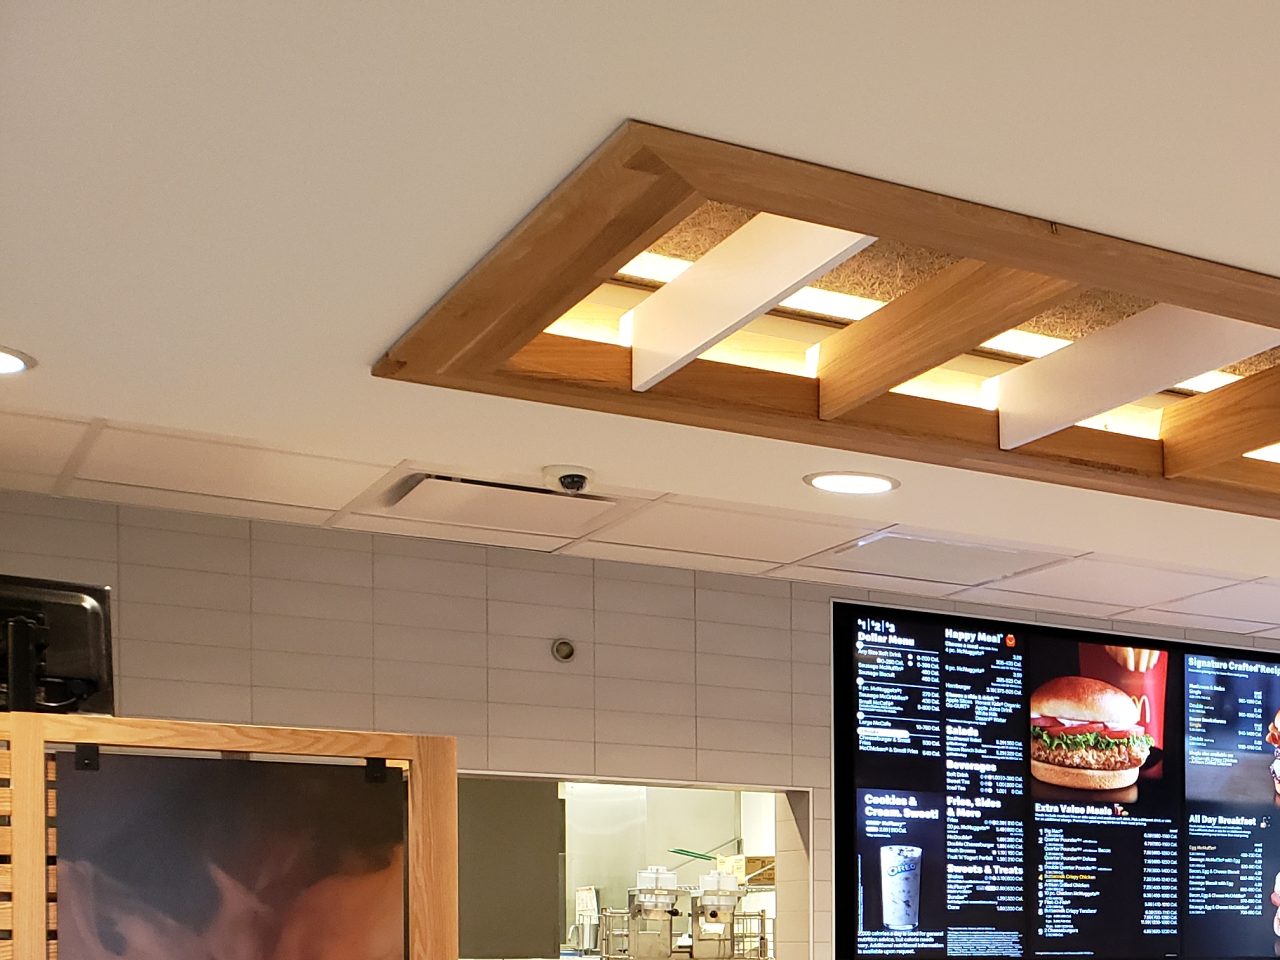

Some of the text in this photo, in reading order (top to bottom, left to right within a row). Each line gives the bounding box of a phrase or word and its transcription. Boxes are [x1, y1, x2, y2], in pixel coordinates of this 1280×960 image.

[858, 631, 915, 646] Dollar Menu
[945, 628, 976, 642] Happy
[1188, 657, 1227, 669] Signature
[946, 725, 979, 737] Salads
[946, 760, 997, 773] Beverages
[864, 794, 917, 806] Cookies &
[946, 796, 1001, 808] Fries, Sides
[903, 808, 939, 819] Sweet!
[946, 807, 981, 818] & More
[1035, 803, 1112, 815] Extra Value Meals
[1189, 814, 1256, 826] All Day Breakfast
[888, 864, 916, 876] OREO
[947, 864, 1024, 875] Sweets & Treats
